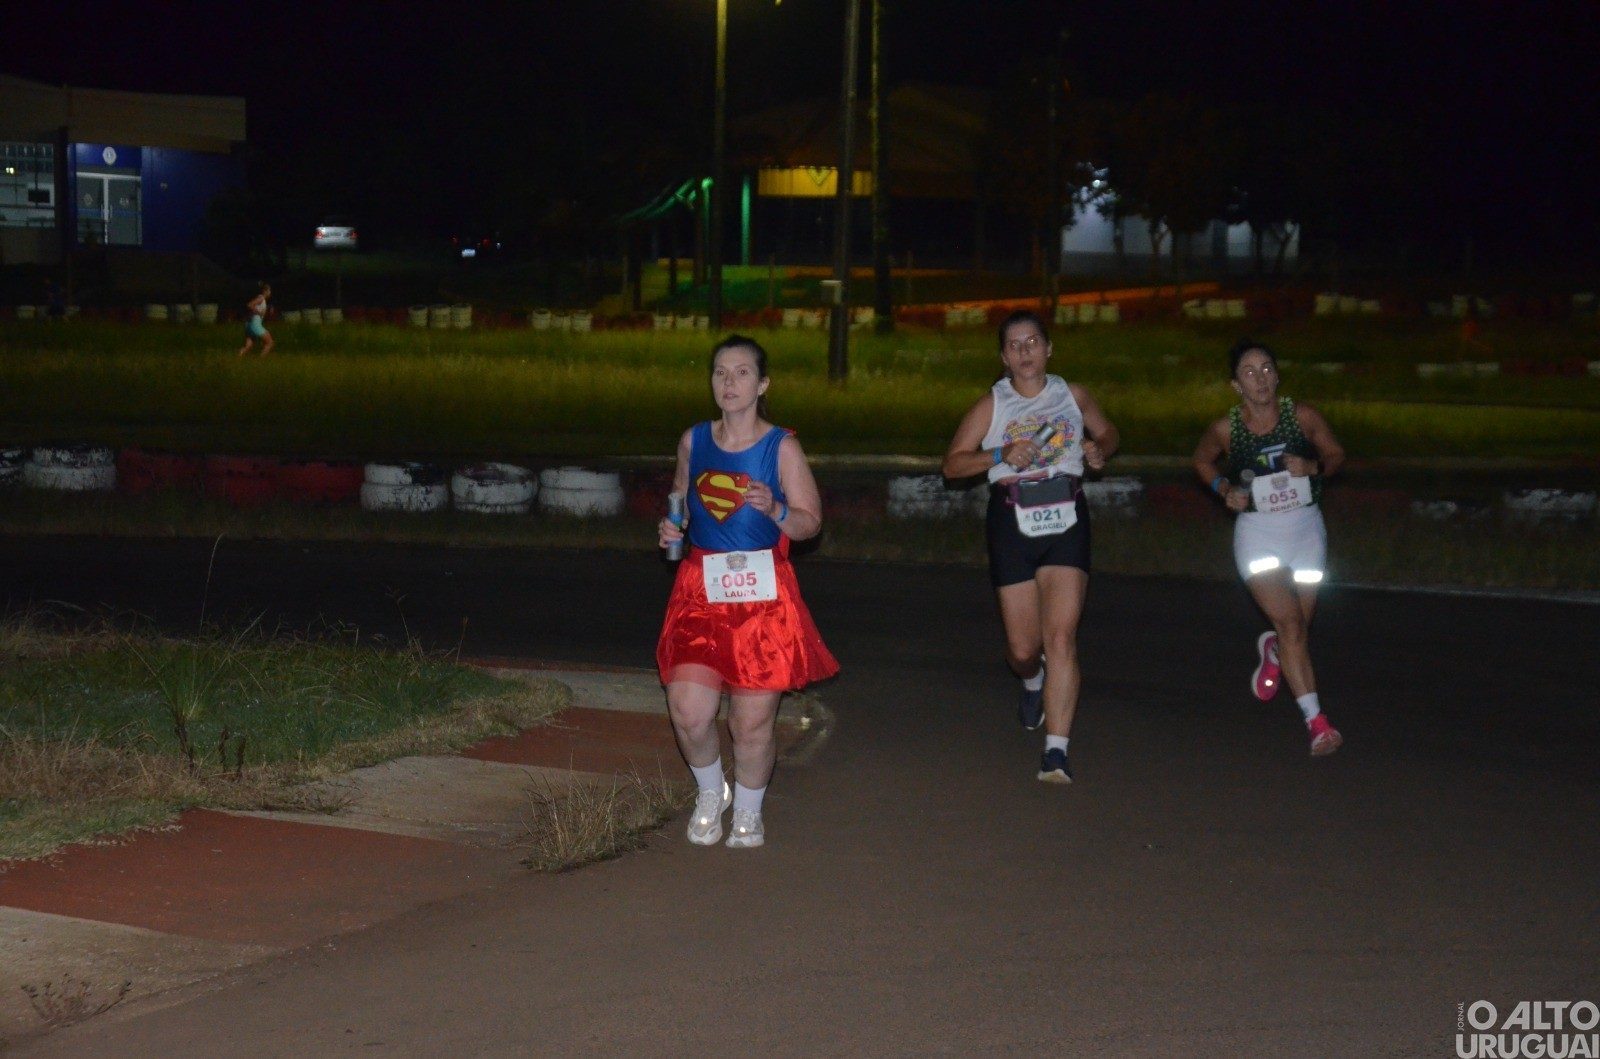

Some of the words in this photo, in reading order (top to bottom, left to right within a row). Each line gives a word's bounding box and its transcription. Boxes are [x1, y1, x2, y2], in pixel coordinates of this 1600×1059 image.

[1269, 488, 1297, 503] 053
[1032, 508, 1061, 522] 021
[721, 571, 757, 588] 005
